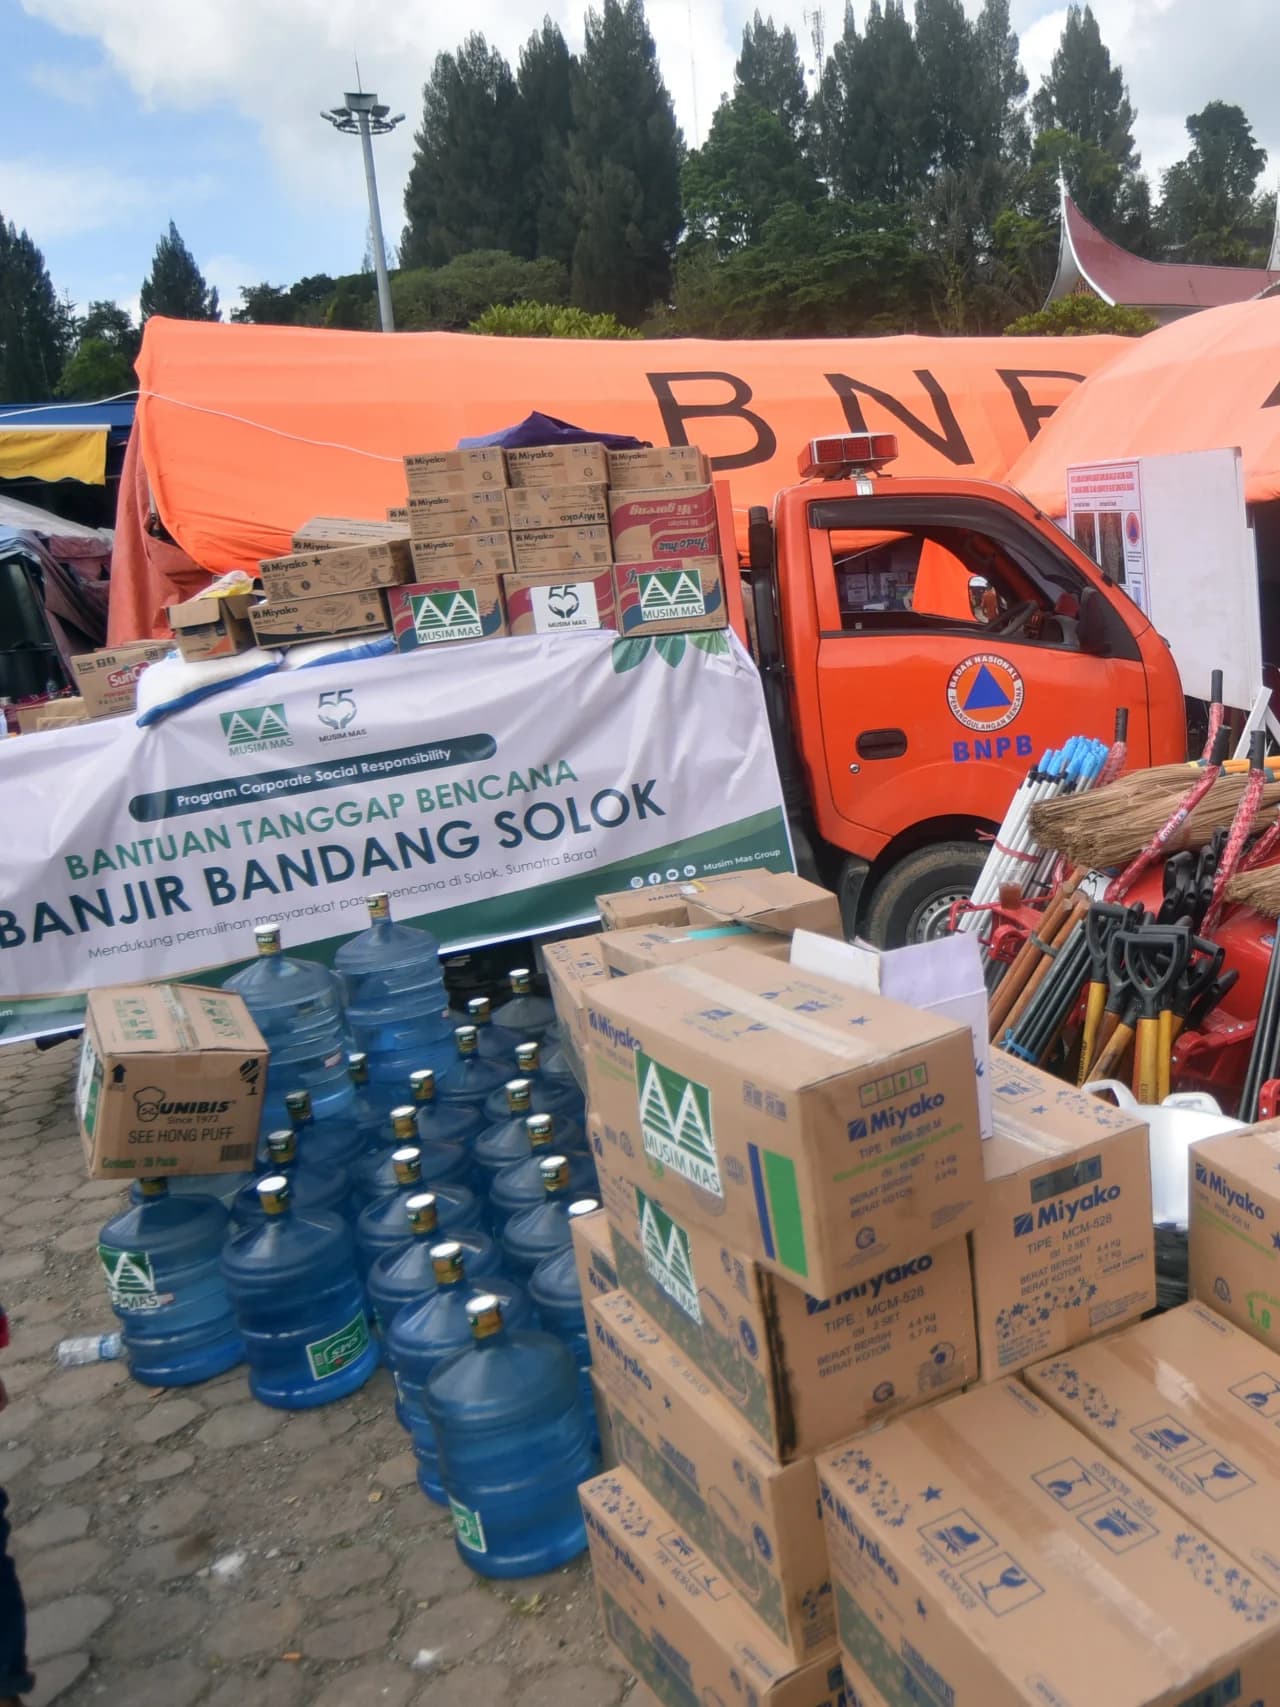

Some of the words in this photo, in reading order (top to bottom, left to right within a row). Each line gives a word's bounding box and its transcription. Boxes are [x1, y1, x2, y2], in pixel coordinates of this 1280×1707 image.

[415, 456, 446, 466] Miyako
[520, 450, 554, 460] Miyako
[418, 497, 449, 507] Miyako
[560, 512, 596, 523] Miyako
[423, 542, 454, 552] Miyako
[524, 534, 555, 543] Miyako
[271, 560, 308, 573] Miyako
[262, 606, 298, 619] Miyako
[643, 608, 678, 620] MUSIM
[680, 605, 705, 617] MAS
[417, 628, 456, 642] MUSIM
[457, 625, 481, 637] MAS
[110, 666, 142, 687] SunC
[949, 659, 974, 689] BADAN
[974, 655, 1021, 682] NASIONAL
[229, 741, 267, 757] MUSIM
[269, 737, 294, 750] MAS
[319, 732, 346, 743] MUSIM
[348, 728, 368, 737] MAS
[953, 734, 1033, 763] BNPB
[177, 786, 237, 809] Program
[240, 772, 311, 798] Corporate
[315, 764, 358, 783] Social
[361, 749, 451, 774] Responsibility
[64, 824, 231, 881] BANTUAN
[236, 793, 406, 846] TANGGAP
[415, 759, 578, 814] BENCANA
[0, 875, 192, 950] BANJIR
[203, 820, 480, 907] BANDANG
[494, 778, 667, 850] SOLOK
[703, 860, 733, 872] Musim
[735, 855, 754, 864] Mas
[754, 849, 781, 861] Group
[89, 932, 173, 959] Mendukung
[177, 917, 251, 946] pemulihan
[255, 899, 337, 926] masyarakat
[449, 873, 462, 888] di
[506, 855, 561, 876] Sumatra
[563, 847, 598, 865] Barat
[600, 1013, 642, 1050] Miyako
[168, 1115, 193, 1124] Since
[870, 1093, 945, 1134] Miyako
[128, 1129, 156, 1145] SEE
[158, 1128, 198, 1143] HONG
[201, 1126, 234, 1142] PUFF
[645, 1131, 689, 1175] MUSIM
[689, 1161, 721, 1193] MAS
[859, 1144, 883, 1160] TIPE
[1038, 1184, 1121, 1229] Miyako
[1209, 1171, 1265, 1221] Miyako
[1028, 1236, 1053, 1254] TIPE
[1062, 1213, 1113, 1241] MCM-528
[1074, 1237, 1091, 1250] SET
[1020, 1267, 1049, 1285] BERAT
[1050, 1253, 1083, 1274] BERSIH
[1021, 1278, 1049, 1297] BERAT
[1051, 1265, 1083, 1285] KOTOR
[824, 1313, 855, 1333] TIPE
[866, 1286, 925, 1318] MCM-528
[880, 1311, 902, 1327] SET
[817, 1345, 851, 1367] BERAT
[853, 1330, 893, 1351] BERSIH
[818, 1359, 852, 1379] BERAT
[854, 1342, 891, 1364] KOTOR
[595, 1520, 645, 1585] Miyako
[836, 1498, 899, 1587] Miyako
